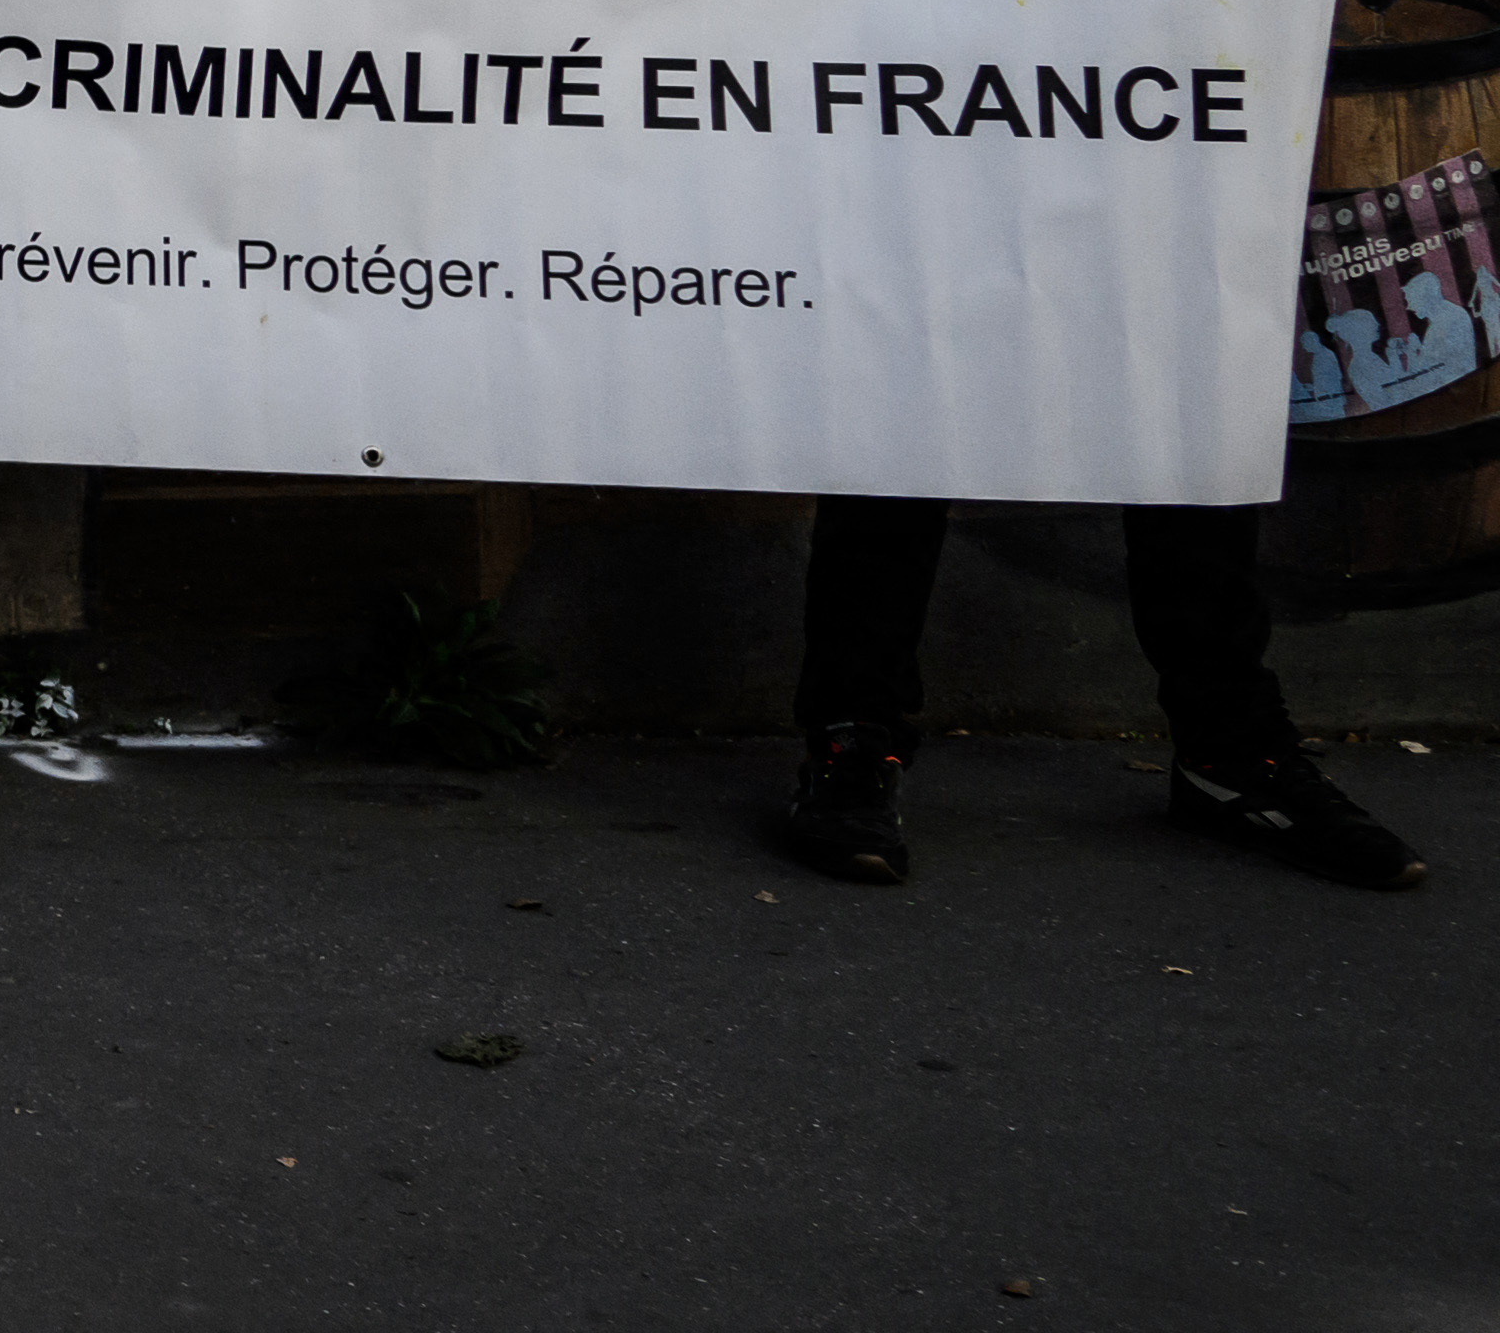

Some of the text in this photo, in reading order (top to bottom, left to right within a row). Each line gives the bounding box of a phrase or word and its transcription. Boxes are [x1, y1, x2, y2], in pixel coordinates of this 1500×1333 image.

[644, 58, 771, 132] EN
[814, 63, 1247, 142] FRANCE
[239, 240, 513, 309] Protéger.
[542, 251, 812, 316] Réparer.
[1301, 236, 1391, 277] ujolais
[1332, 234, 1442, 283] nouveau
